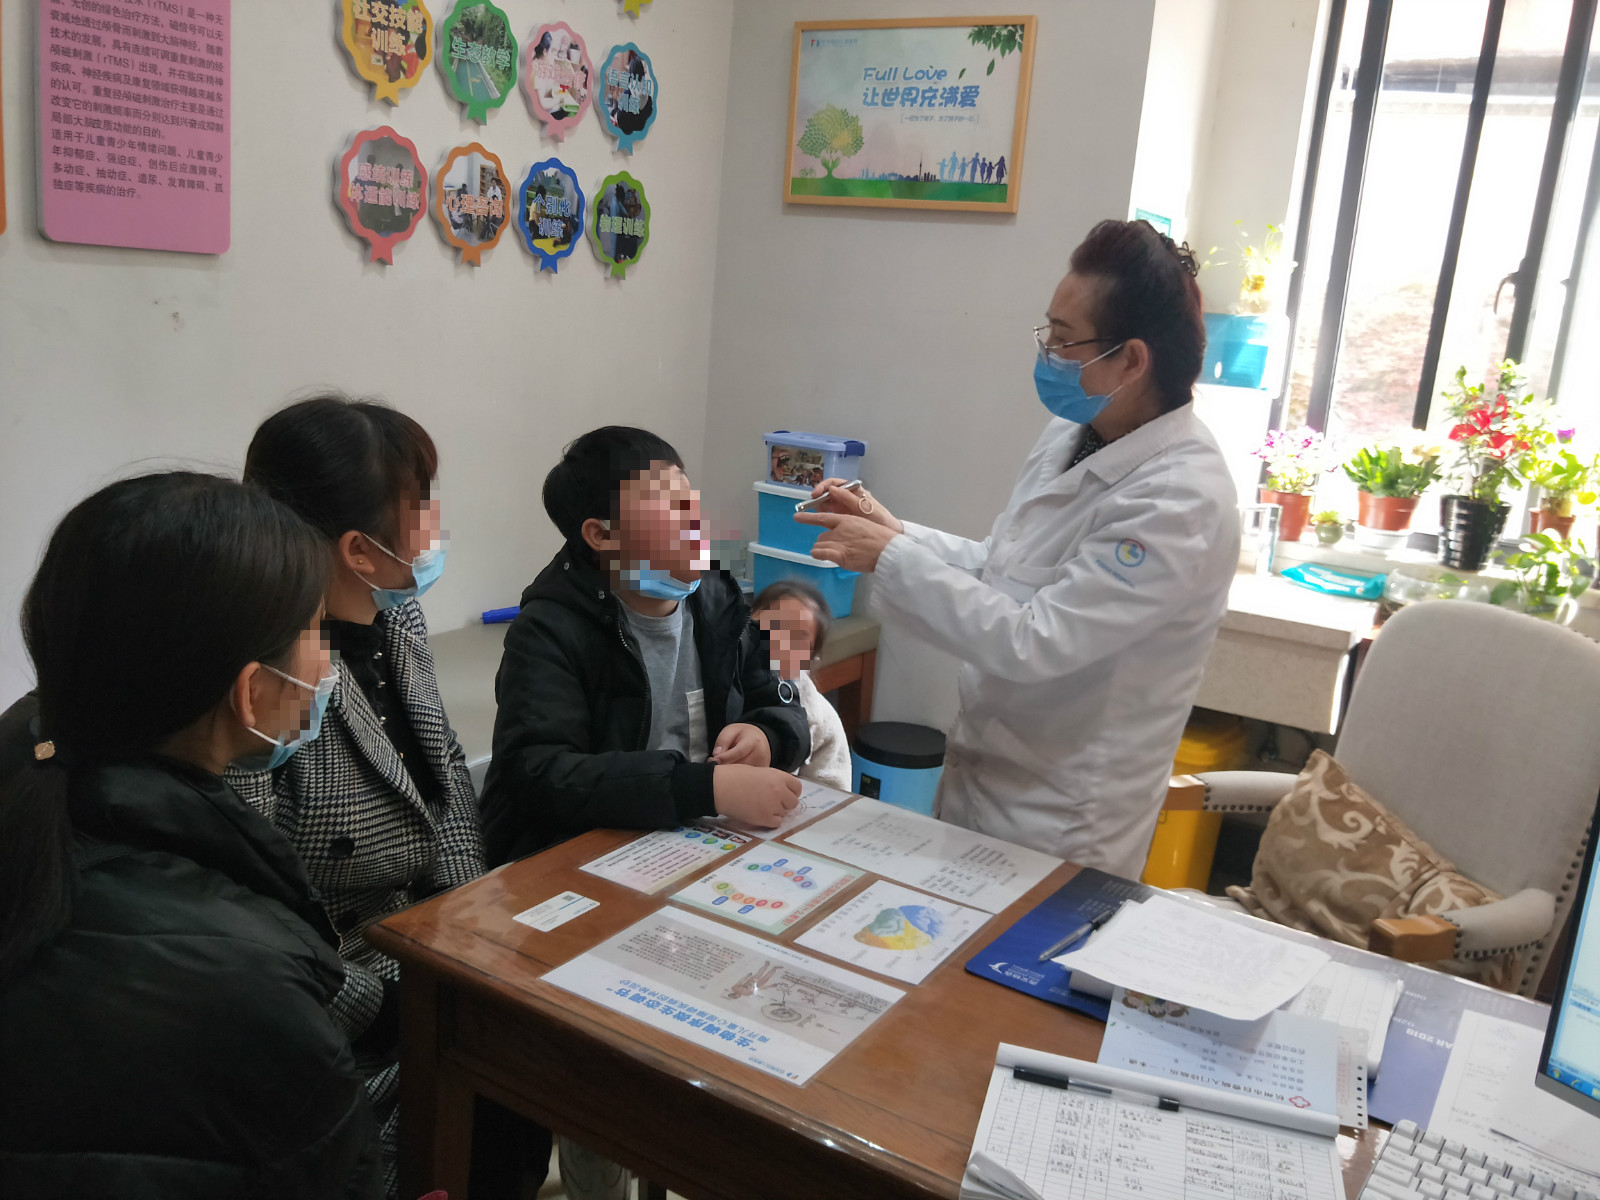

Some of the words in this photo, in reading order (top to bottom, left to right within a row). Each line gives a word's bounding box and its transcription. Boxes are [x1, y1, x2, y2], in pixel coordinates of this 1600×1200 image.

[352, 0, 423, 33] 社交技能
[370, 28, 406, 56] 训练
[451, 37, 511, 71] 生态教学
[606, 66, 652, 95] 语言认知
[863, 66, 899, 81] Full
[902, 66, 948, 81] Love
[617, 91, 641, 115] 训练
[862, 84, 981, 108] 让世界充满爱
[446, 192, 504, 219] 心理咨询
[532, 192, 572, 218] 个别化
[538, 217, 564, 239] 训练
[599, 212, 645, 239] 物理训练
